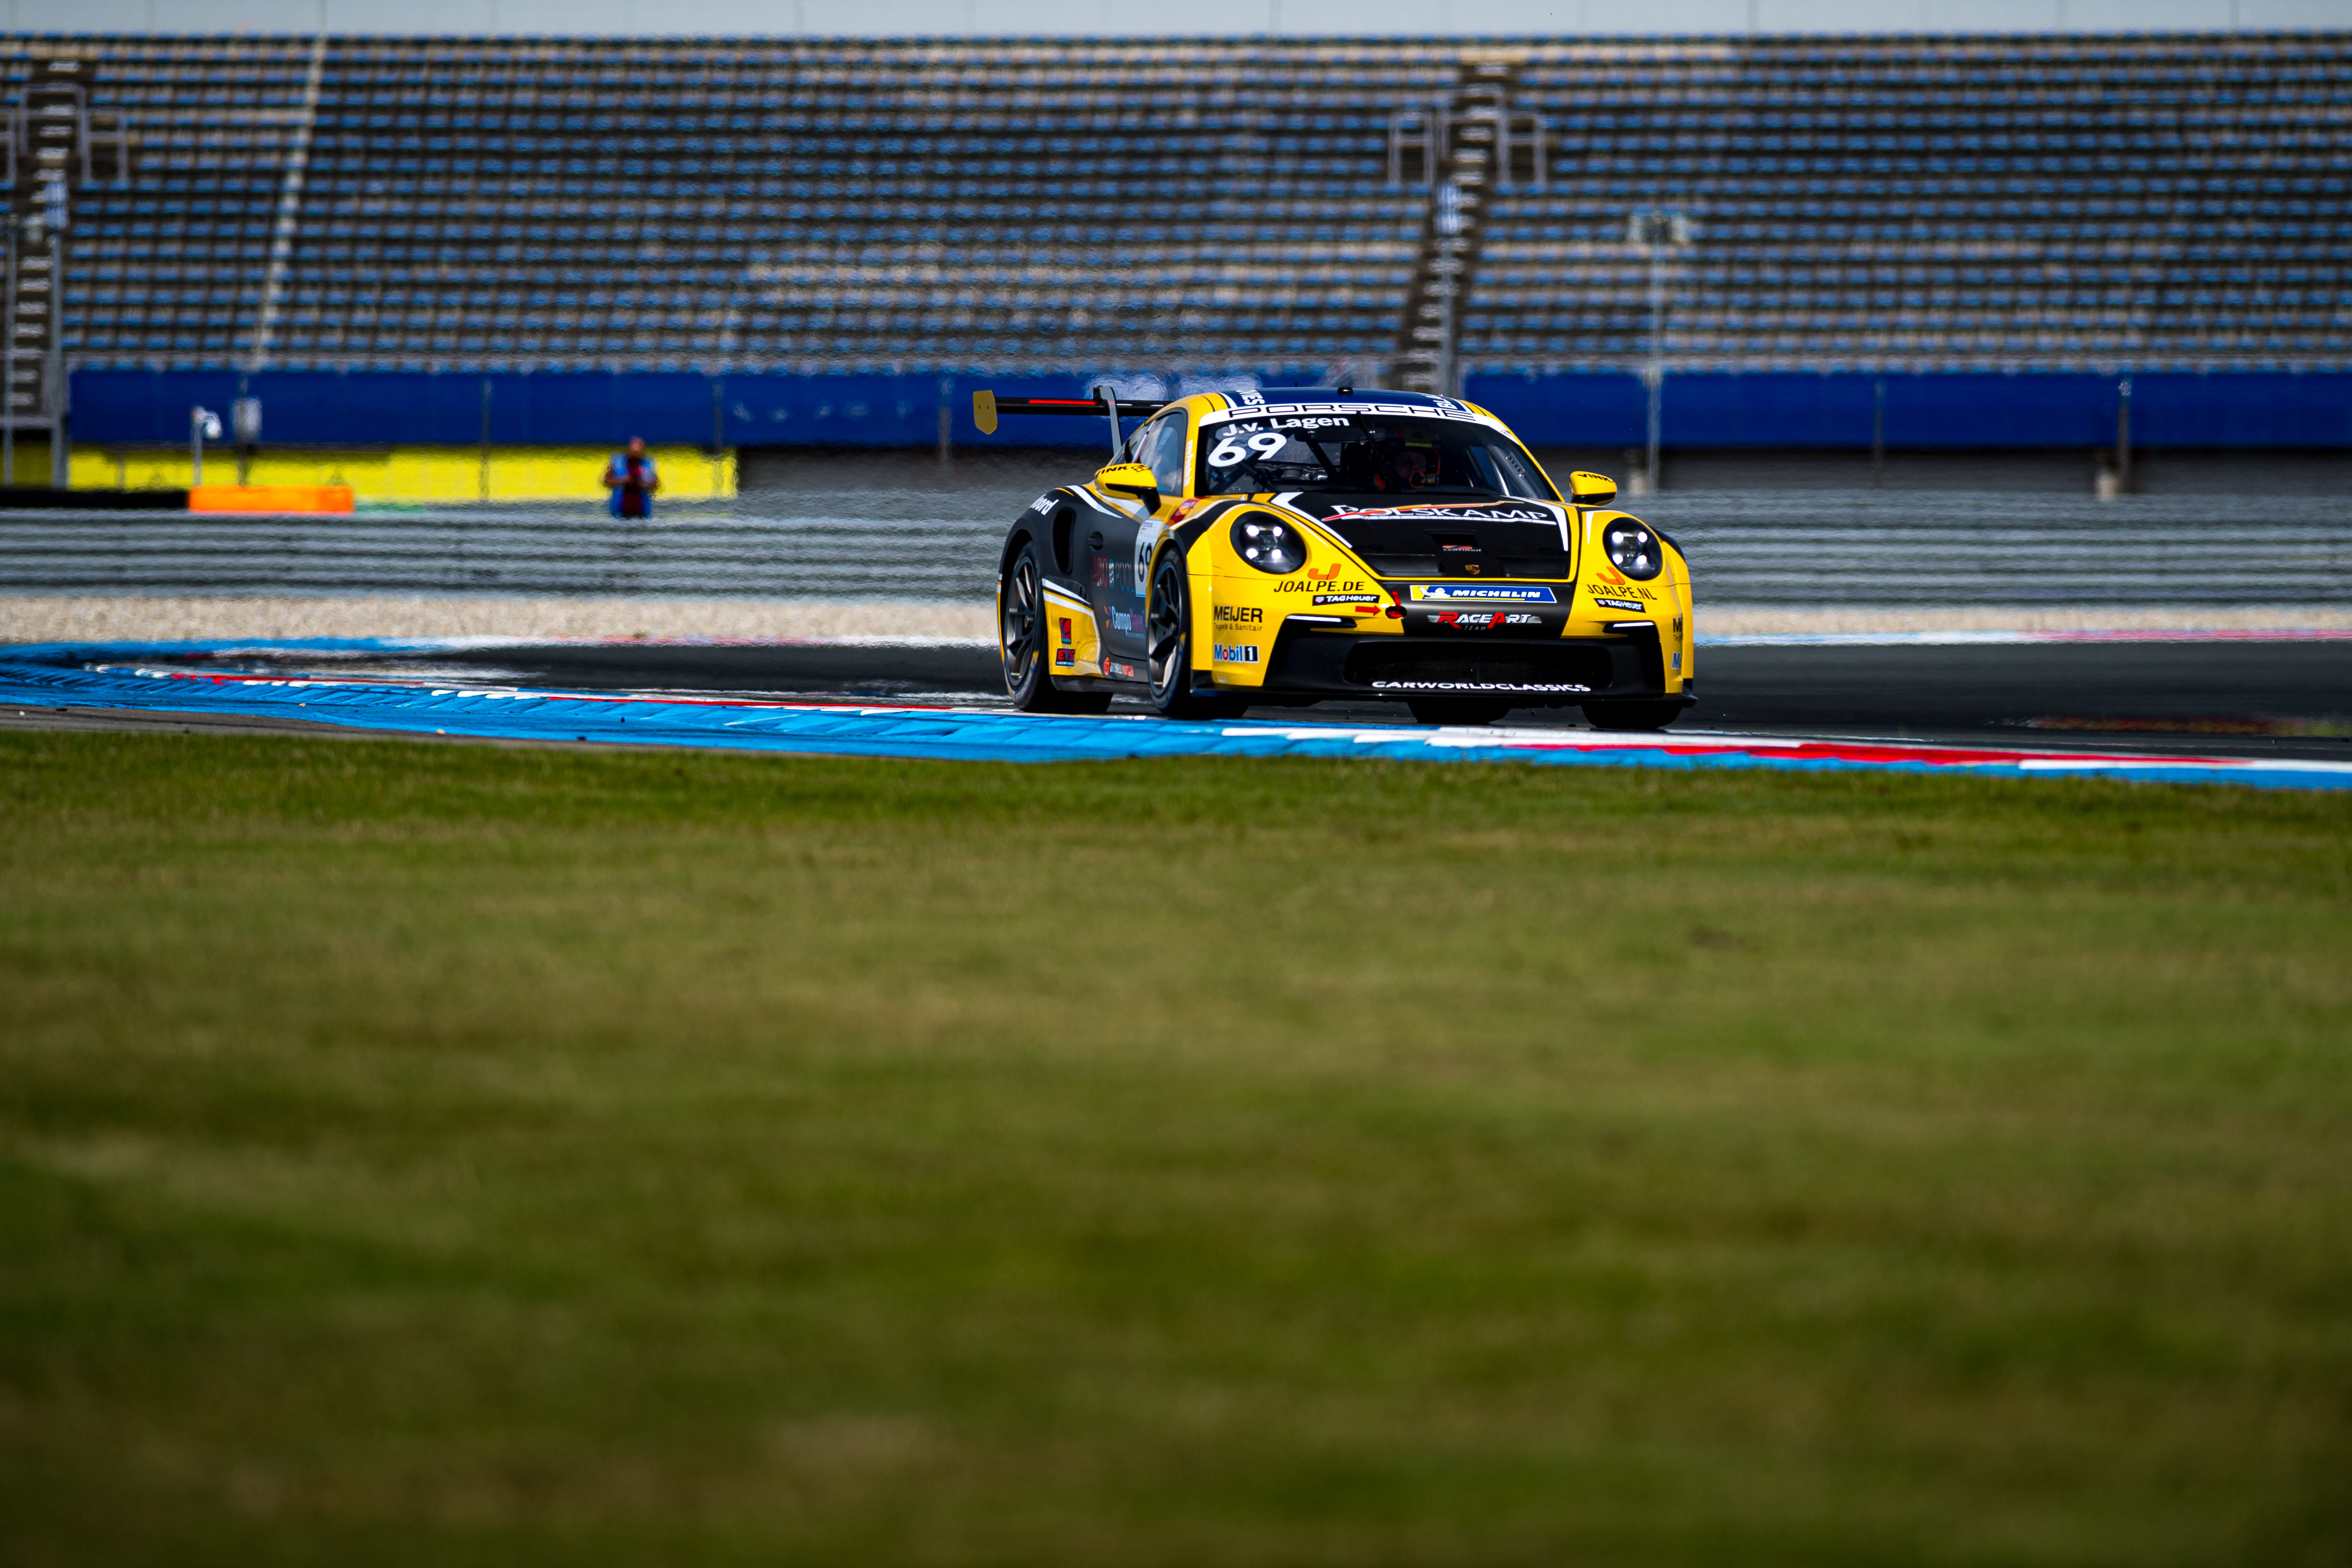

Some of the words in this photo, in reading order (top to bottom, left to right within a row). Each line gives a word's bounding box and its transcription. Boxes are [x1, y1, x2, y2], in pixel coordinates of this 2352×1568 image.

[1228, 404, 1476, 421] PORSCHE
[1223, 422, 1263, 436] J.v.
[1270, 417, 1350, 429] Lagen
[1208, 432, 1287, 467] 69
[1274, 581, 1365, 592] JOALPE.DE
[1452, 590, 1541, 598] MICHELIN
[1587, 585, 1658, 600] JOALPE.NL
[1214, 606, 1263, 623] MEIJER
[1214, 643, 1243, 662] Mobil
[1372, 681, 1591, 691] CARWORLDCLASSICS
